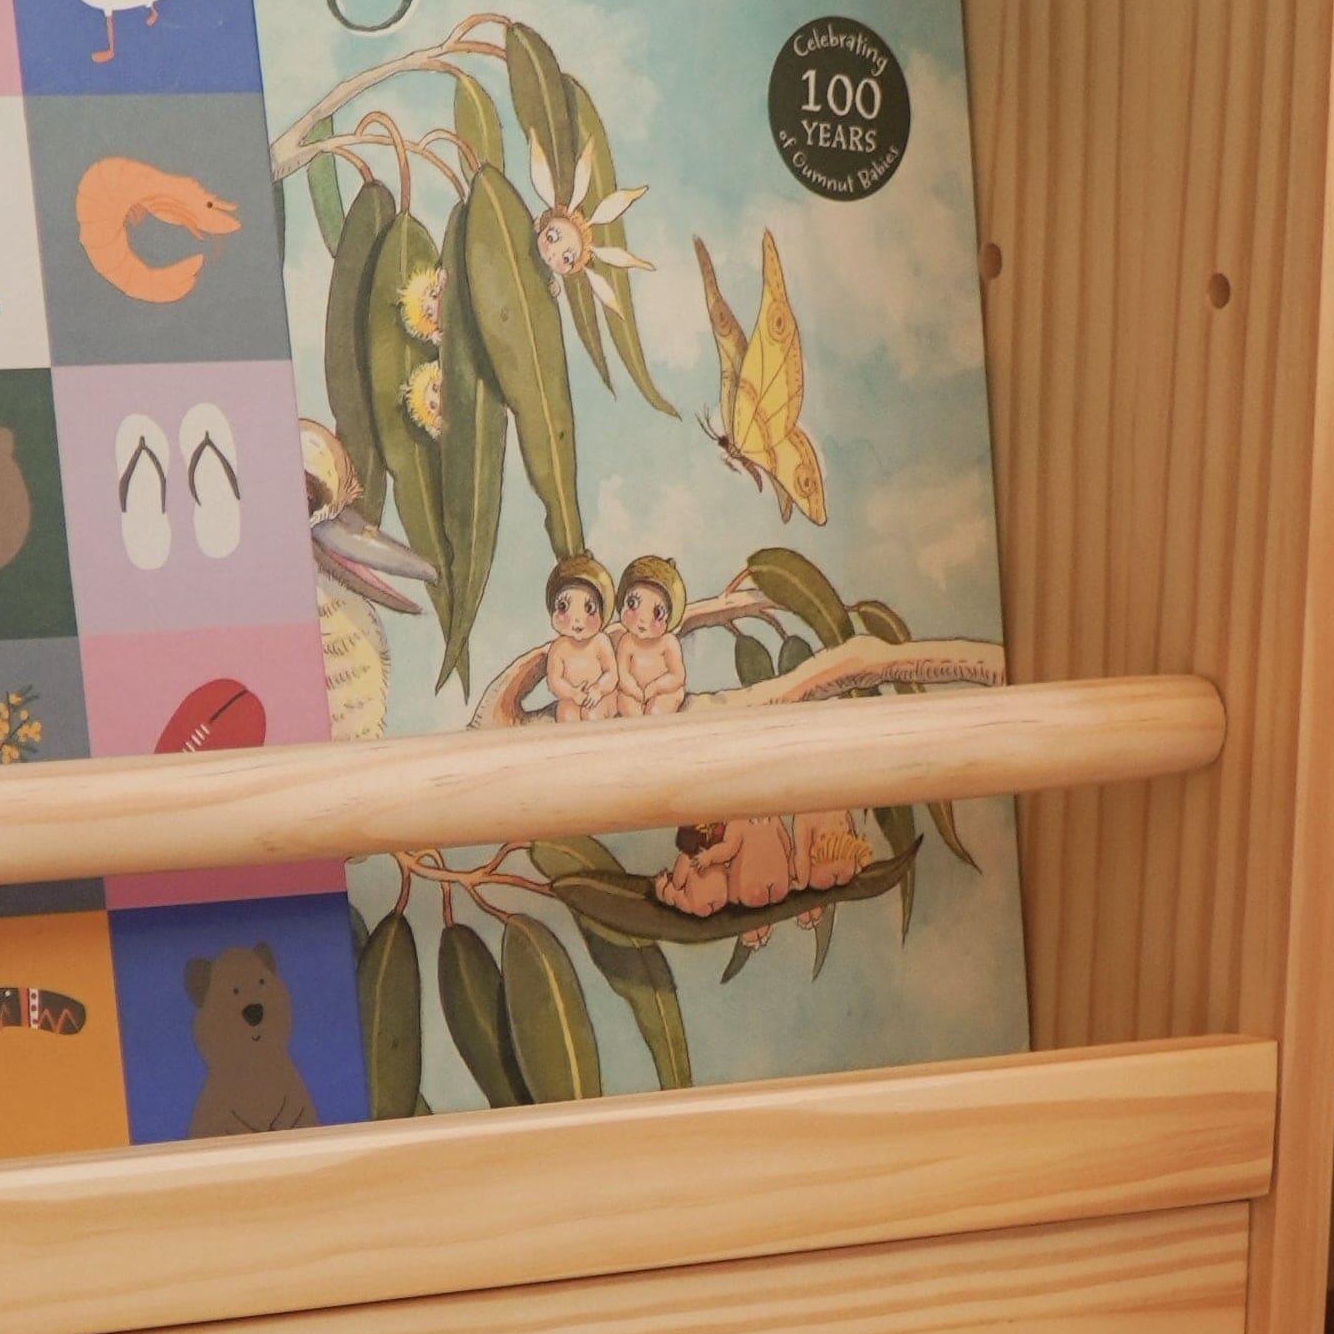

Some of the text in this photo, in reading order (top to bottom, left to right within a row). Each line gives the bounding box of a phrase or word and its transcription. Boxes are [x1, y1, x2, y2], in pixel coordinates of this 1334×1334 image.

[793, 23, 889, 78] Celebrating
[801, 69, 882, 120] 100
[779, 130, 899, 193] of Gumnut Babies
[801, 119, 877, 153] YEARS
